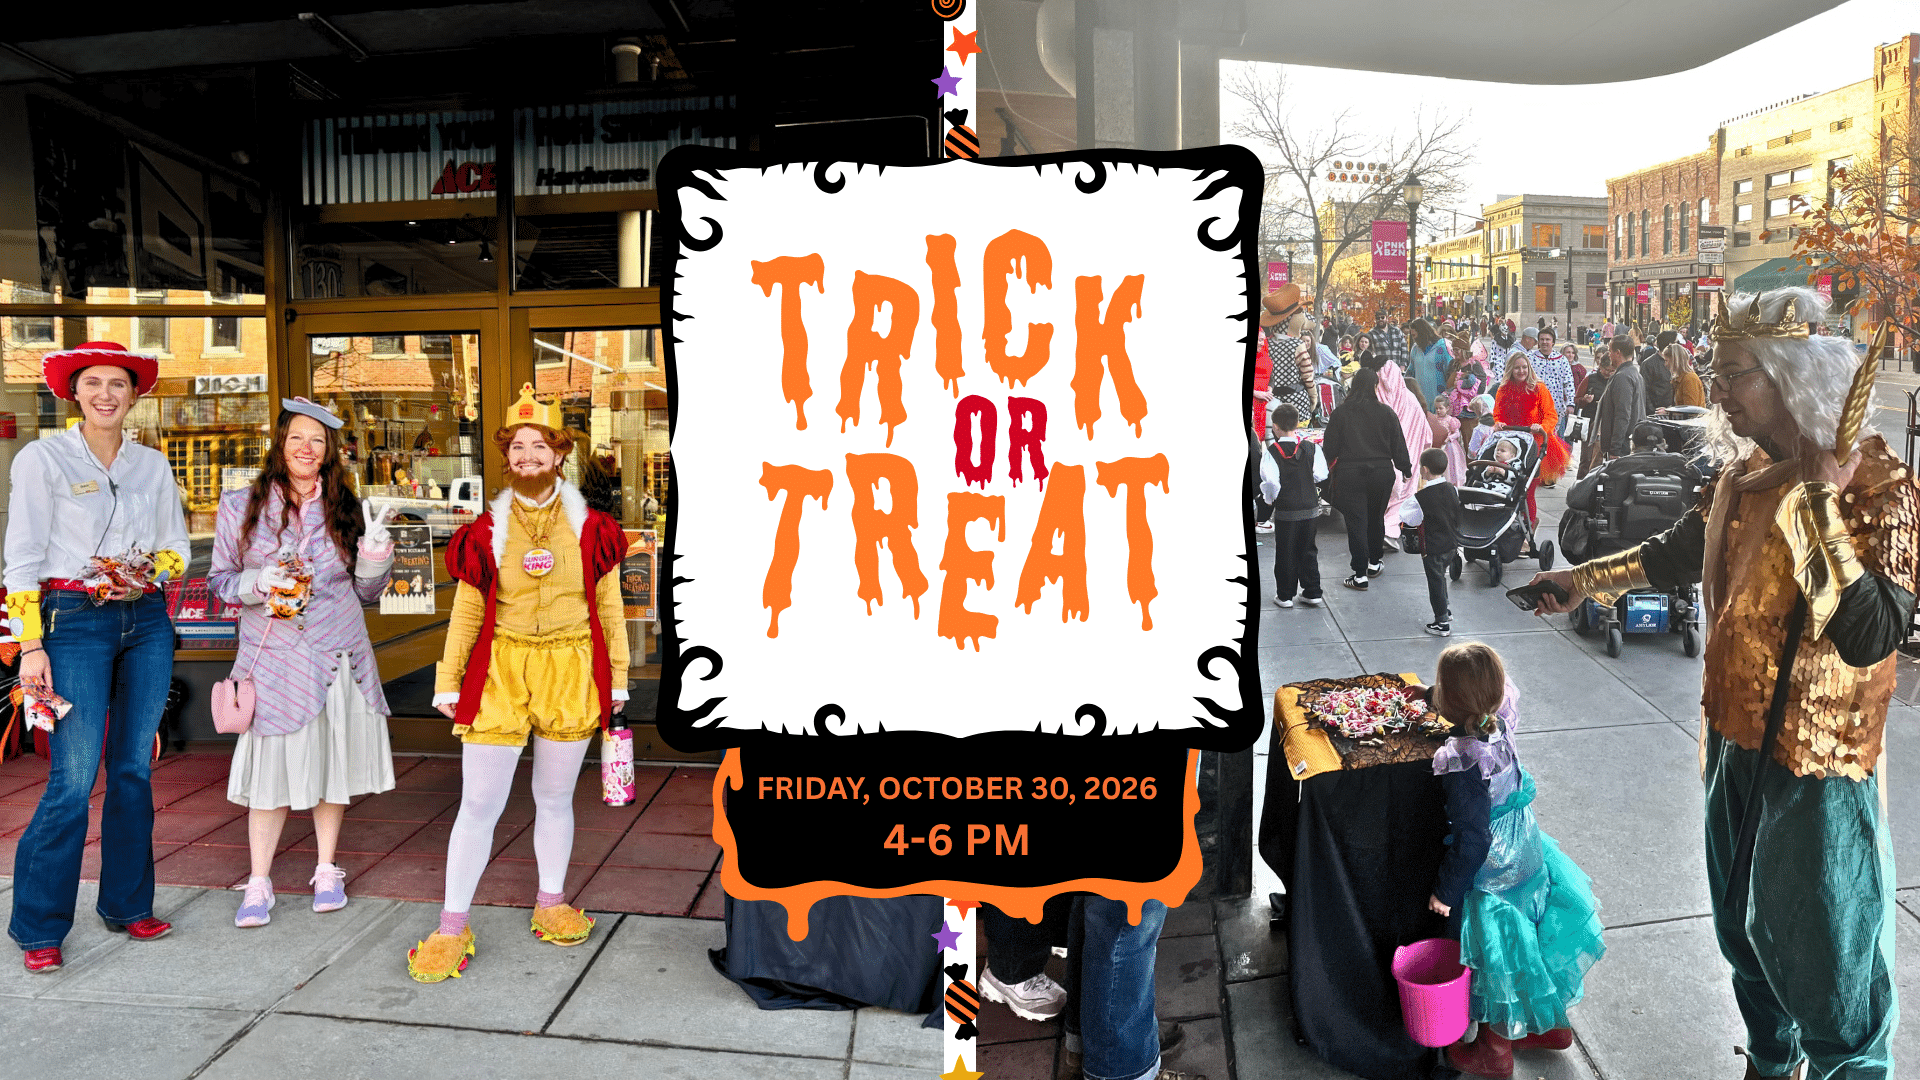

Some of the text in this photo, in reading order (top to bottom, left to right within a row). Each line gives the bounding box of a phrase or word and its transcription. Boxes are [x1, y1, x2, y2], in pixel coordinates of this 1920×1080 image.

[431, 158, 650, 195] ACE Hardware
[1384, 241, 1405, 249] PNK
[1384, 248, 1405, 257] BZN
[524, 561, 552, 571] KING
[177, 606, 205, 619] ACE
[222, 606, 243, 619] AC
